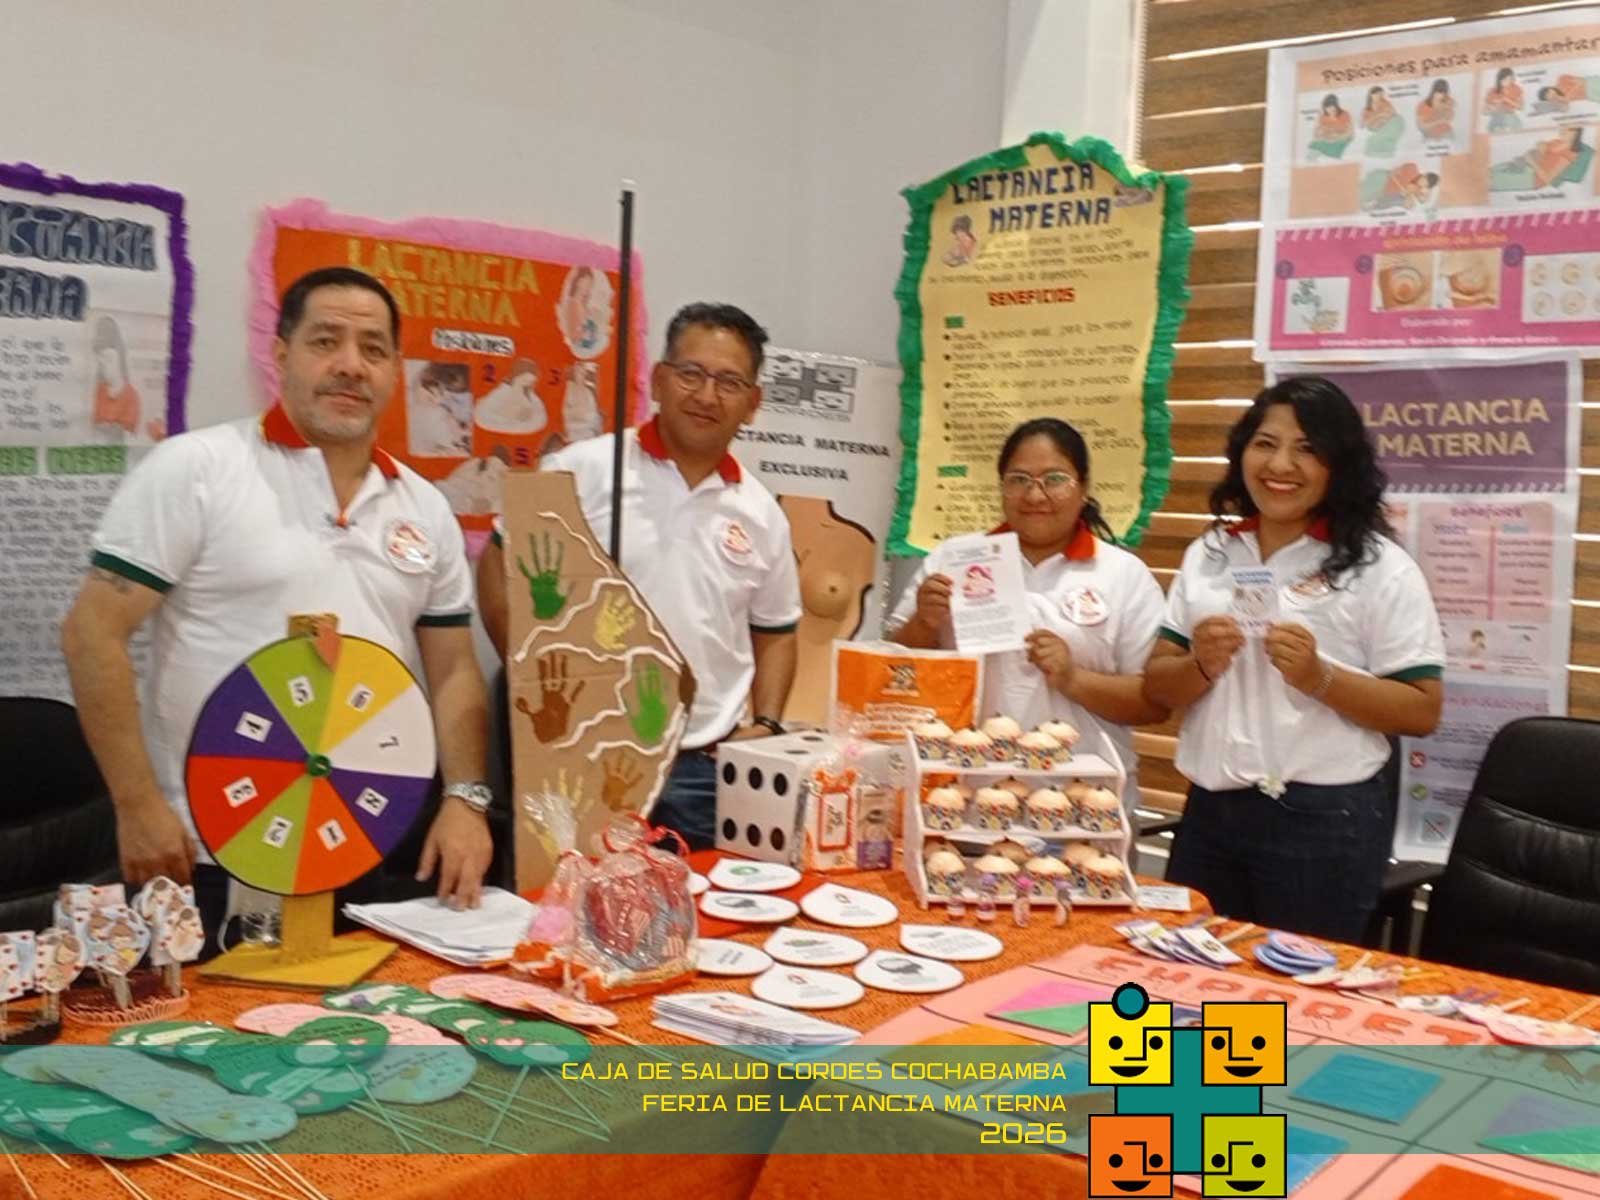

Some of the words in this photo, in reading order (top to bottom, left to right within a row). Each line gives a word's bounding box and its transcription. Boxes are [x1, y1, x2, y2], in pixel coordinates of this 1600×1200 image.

[1322, 60, 1416, 83] Posiciones
[1421, 52, 1468, 76] para
[952, 162, 1095, 204] LACTANCIA
[989, 198, 1113, 233] MATERNA
[348, 238, 540, 295] LACTANCIA
[381, 277, 521, 327] ATERNA
[1362, 398, 1549, 427] LACTANCIA
[736, 430, 805, 447] CTANCIA
[815, 438, 890, 456] MATERNA
[1378, 431, 1534, 458] MATERNA
[760, 461, 848, 480] EXCLUSIVA
[294, 682, 309, 705] 5
[379, 736, 399, 749] 7
